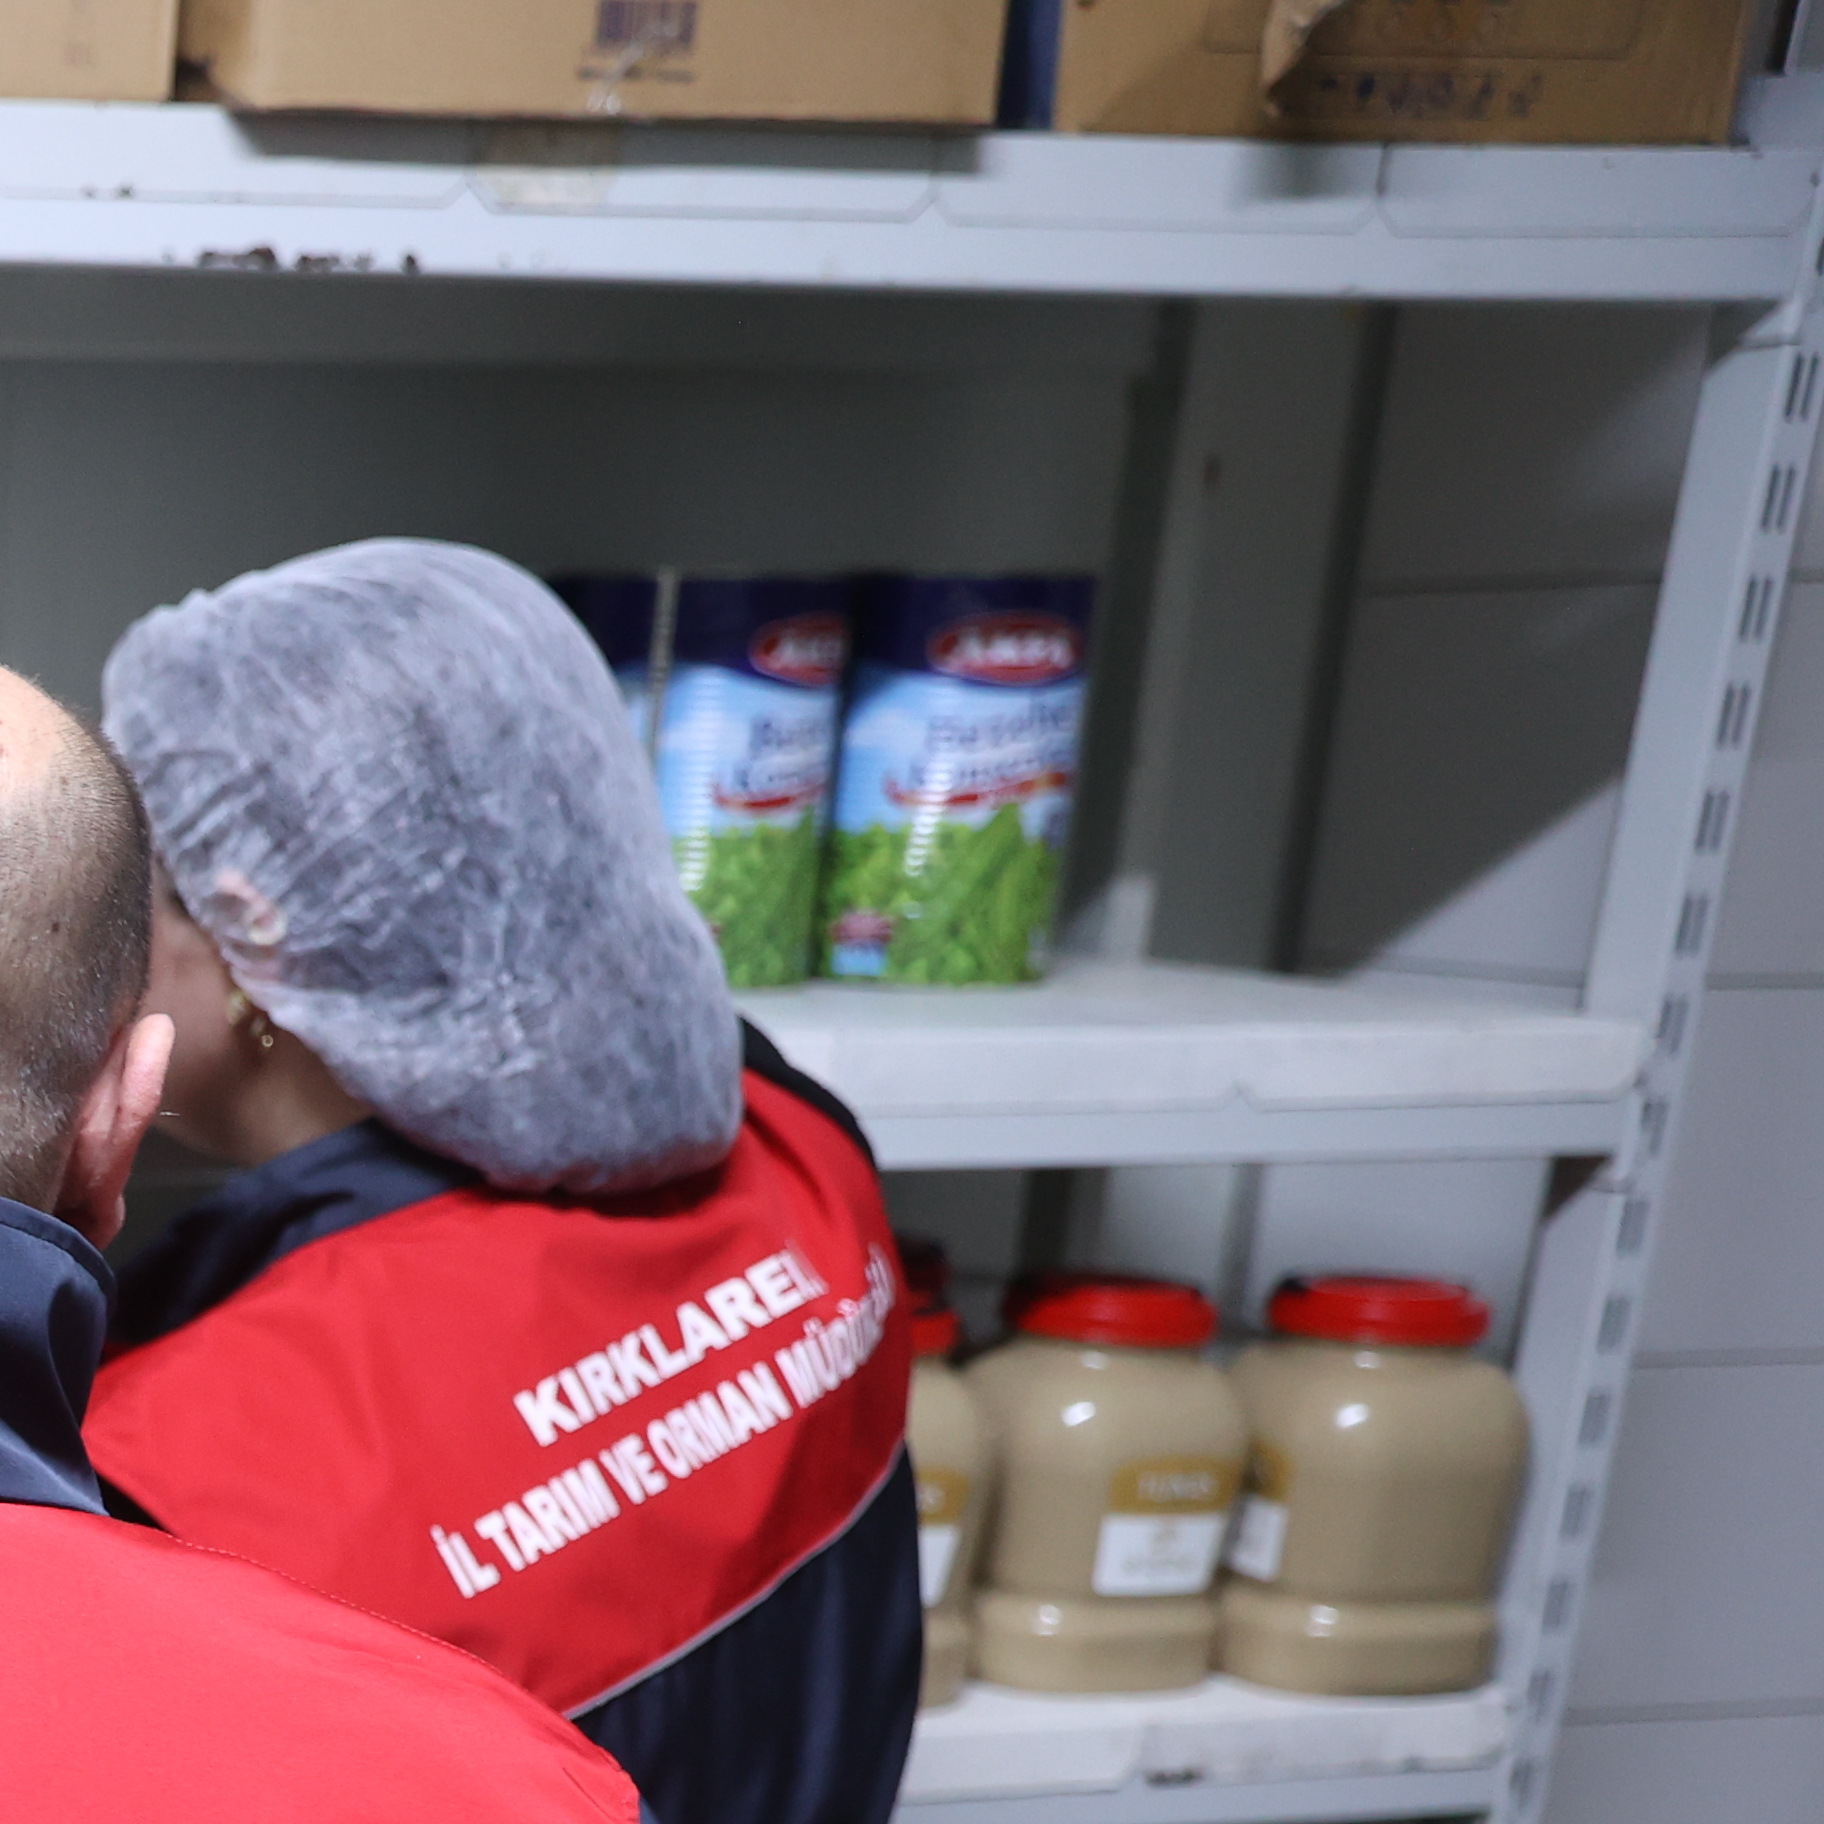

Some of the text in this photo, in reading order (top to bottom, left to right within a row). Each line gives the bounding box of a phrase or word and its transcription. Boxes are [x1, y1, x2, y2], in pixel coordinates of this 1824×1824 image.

[430, 1523, 501, 1599] İL
[474, 1458, 621, 1572] TARIM
[599, 1432, 669, 1505] VE
[646, 1361, 794, 1480] ORMAN
